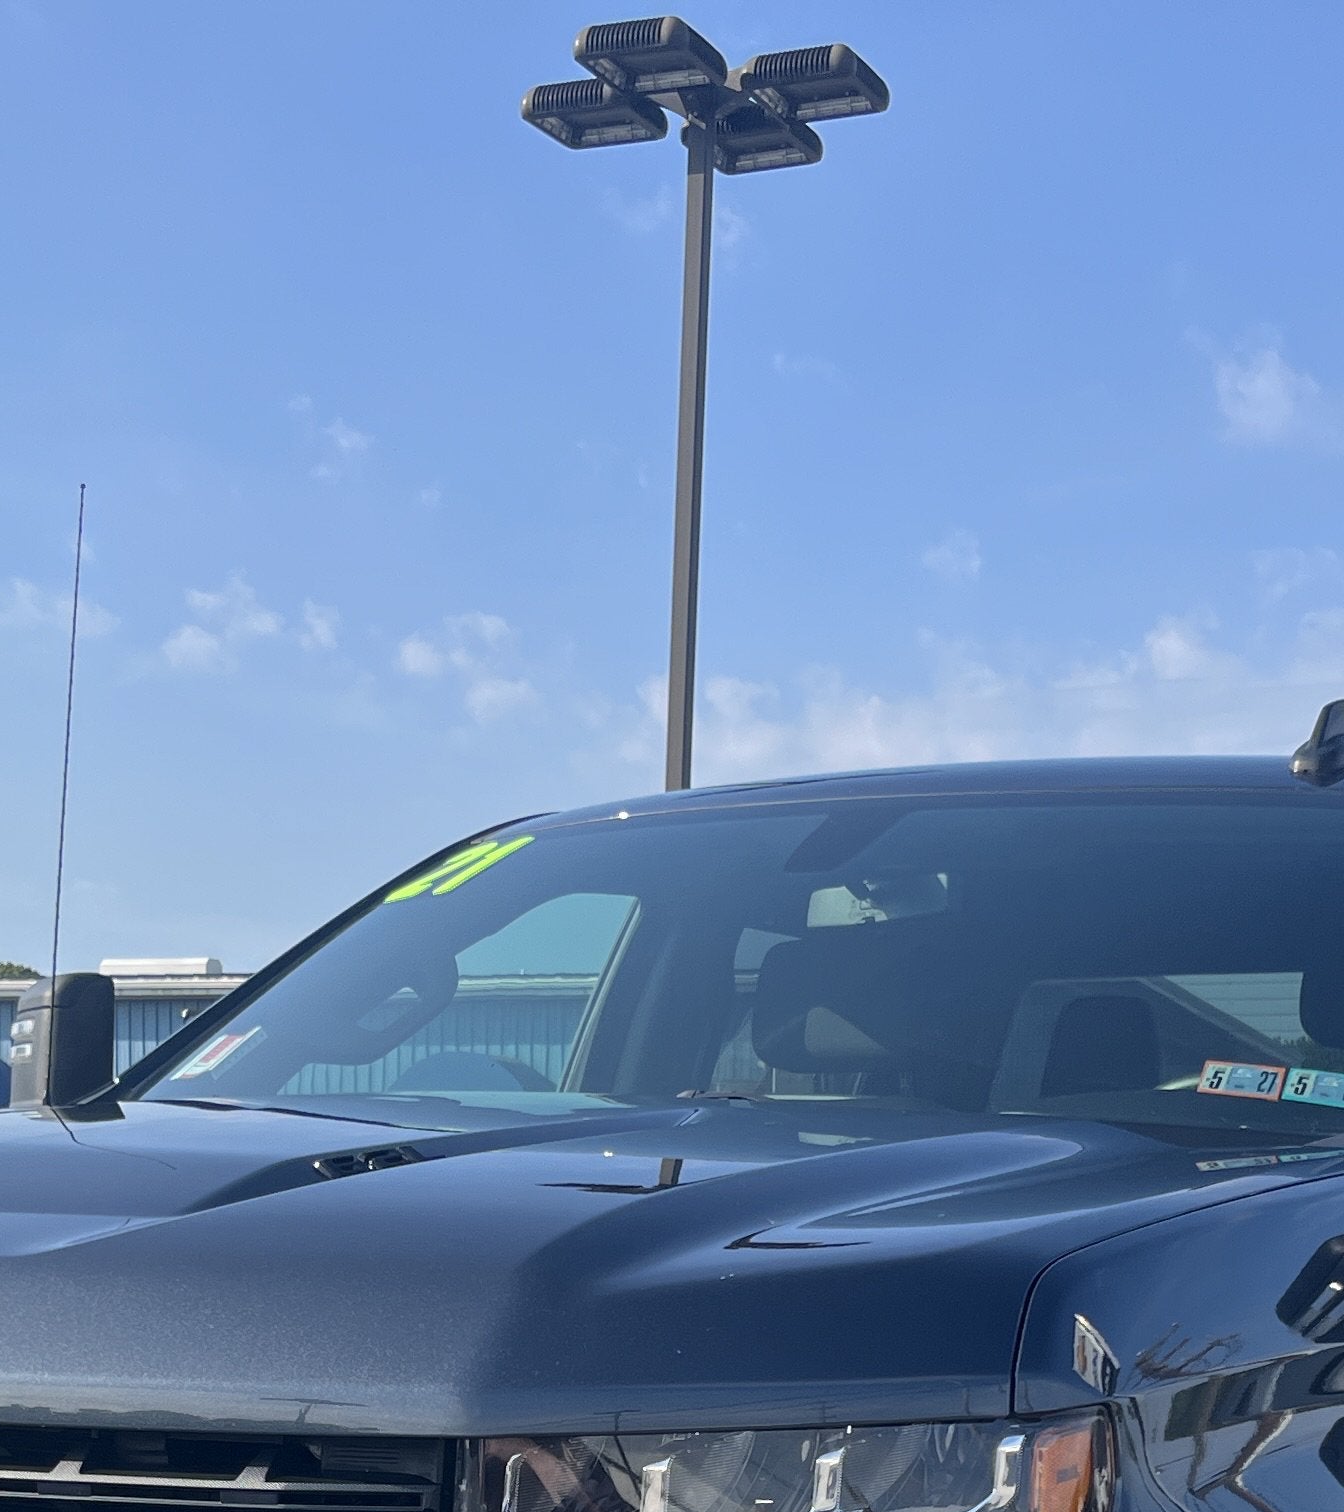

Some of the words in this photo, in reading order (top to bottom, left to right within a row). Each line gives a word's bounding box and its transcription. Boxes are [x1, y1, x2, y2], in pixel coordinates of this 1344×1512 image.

[1209, 1070, 1226, 1090] 5
[1256, 1071, 1279, 1094] 27
[1293, 1076, 1309, 1096] 5
